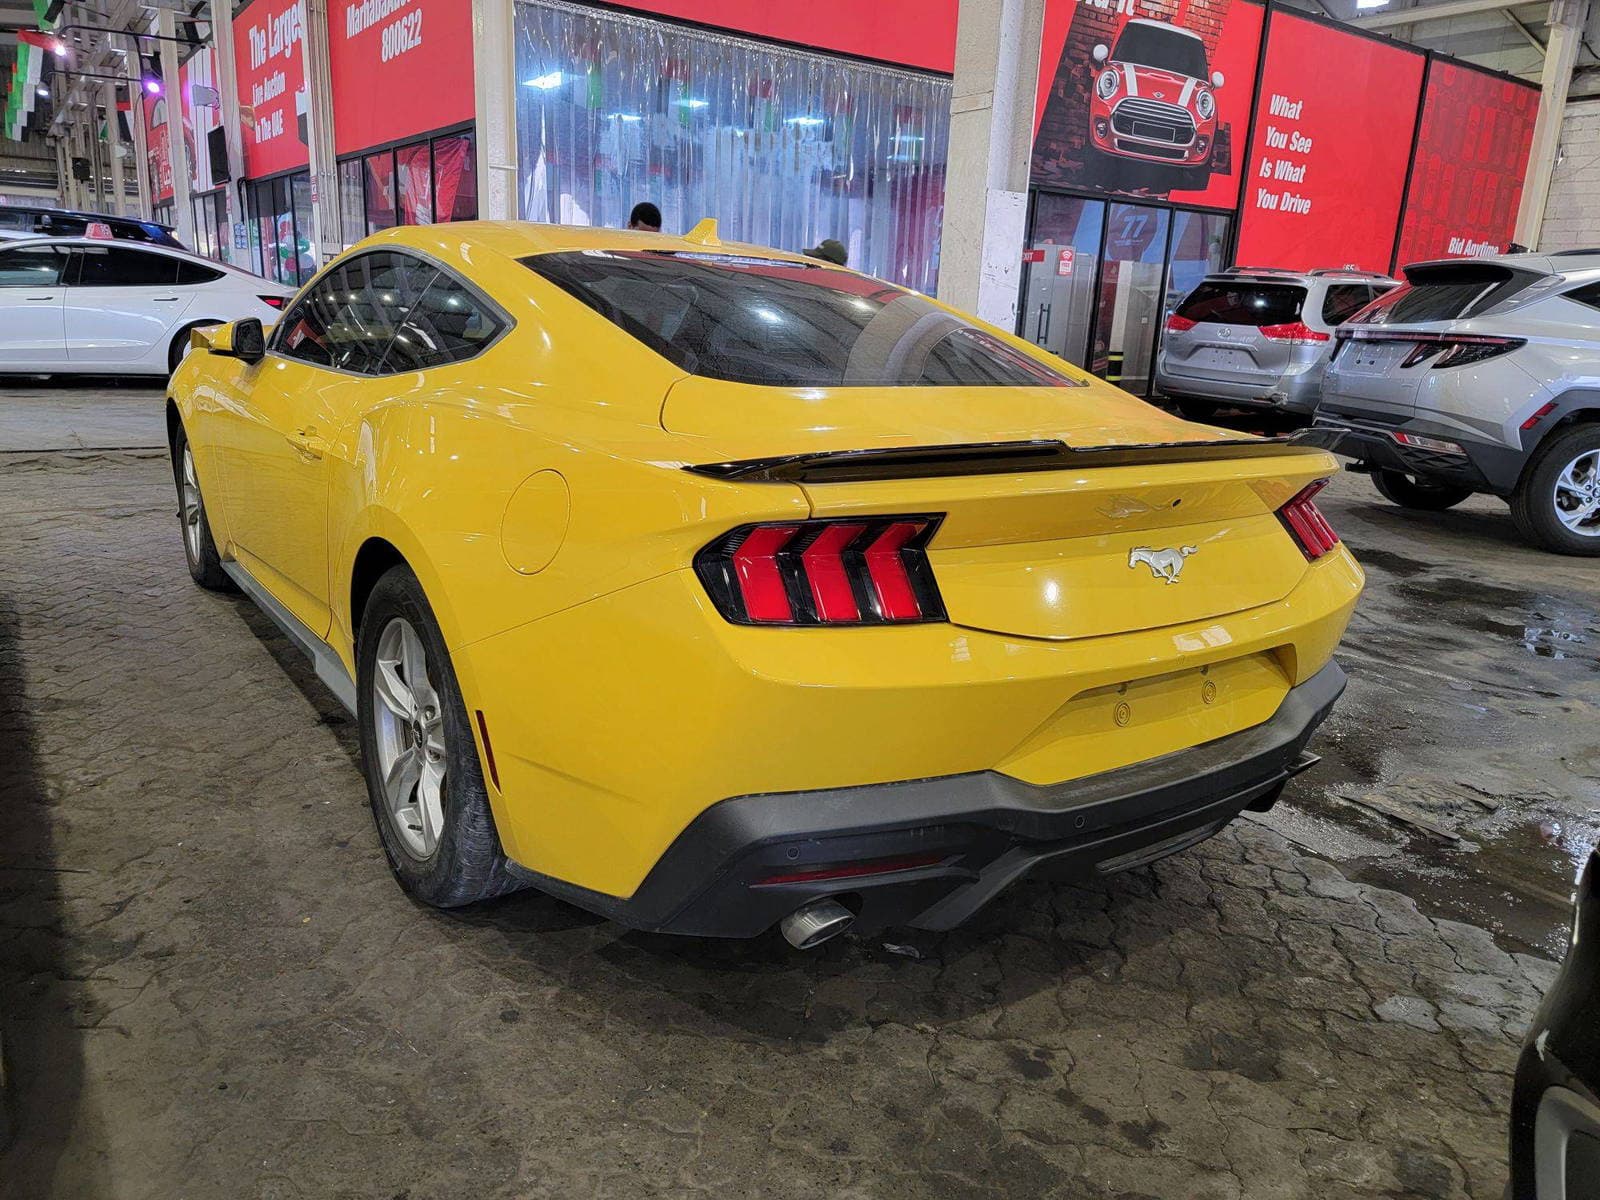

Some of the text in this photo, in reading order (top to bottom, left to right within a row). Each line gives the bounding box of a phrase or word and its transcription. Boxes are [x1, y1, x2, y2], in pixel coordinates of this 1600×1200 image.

[249, 2, 302, 70] The Large
[382, 8, 422, 63] 800622
[264, 70, 286, 102] Auction
[1269, 94, 1303, 120] What
[1265, 126, 1312, 154] You See
[1259, 157, 1306, 184] Is What
[1256, 188, 1311, 215] You Drive
[1022, 252, 1034, 261] XIT
[1447, 237, 1499, 257] Bid Anytime
